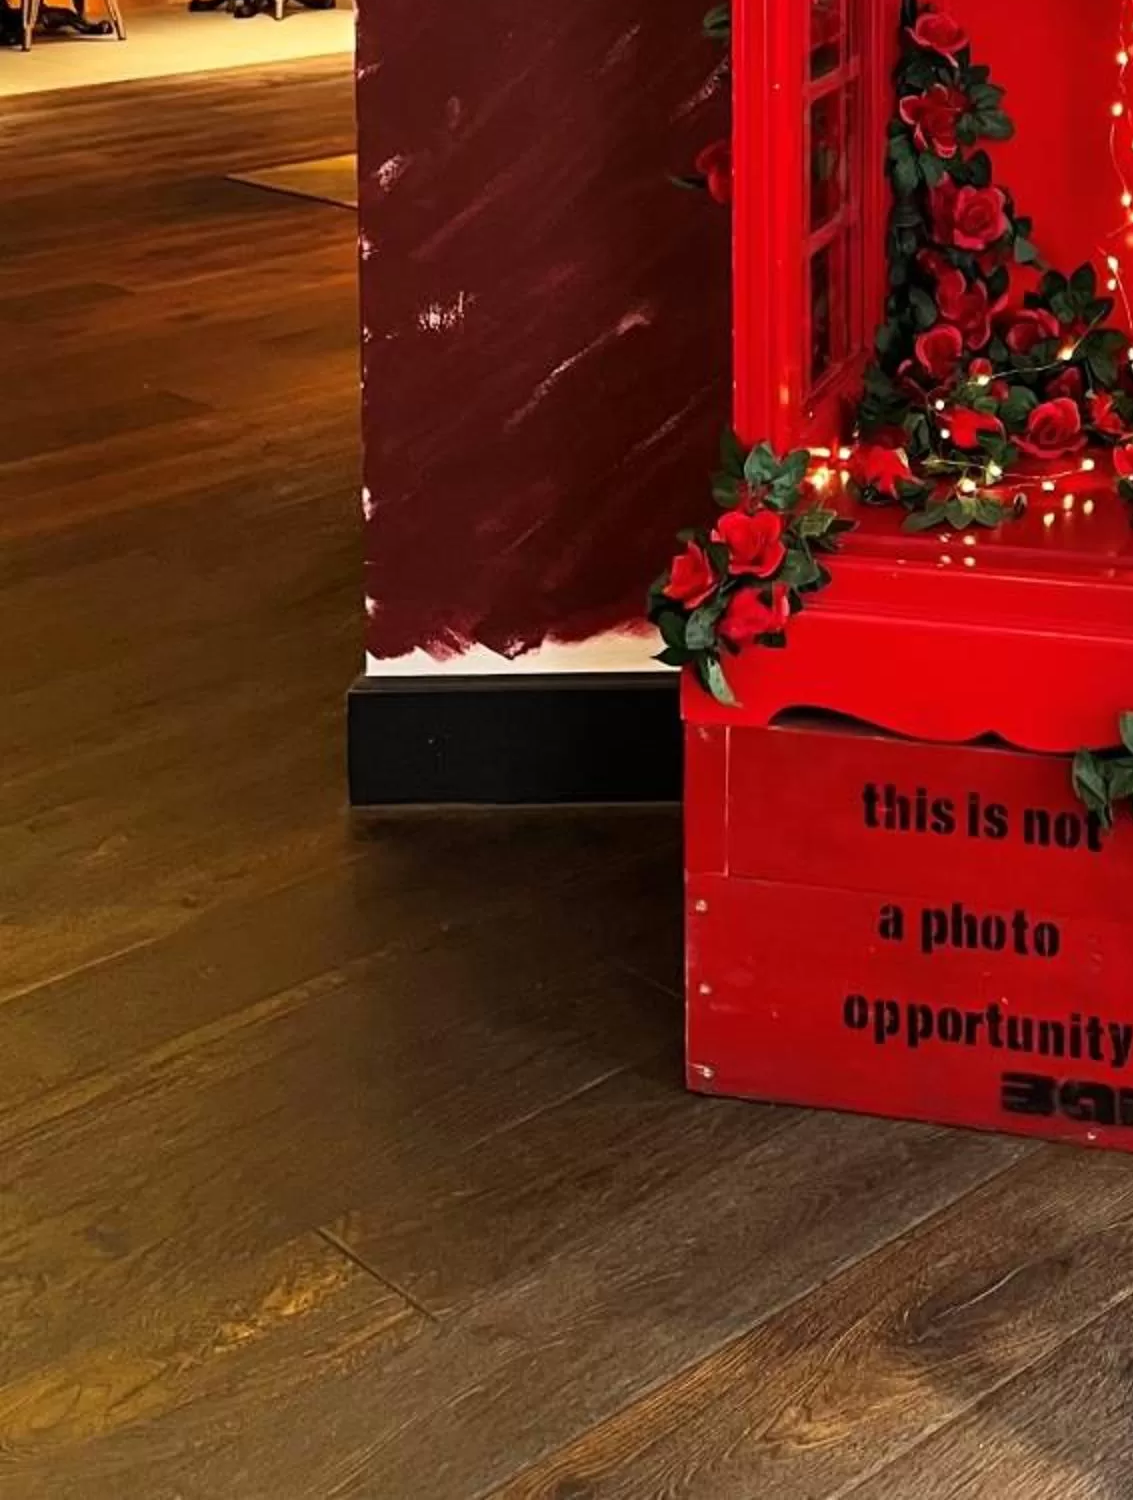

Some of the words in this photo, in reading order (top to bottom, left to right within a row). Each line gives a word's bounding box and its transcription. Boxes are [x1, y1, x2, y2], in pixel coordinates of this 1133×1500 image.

[862, 782, 956, 836] this
[967, 792, 1009, 840] is
[1023, 806, 1102, 852] not
[879, 902, 905, 941] a
[920, 902, 1061, 958] photo
